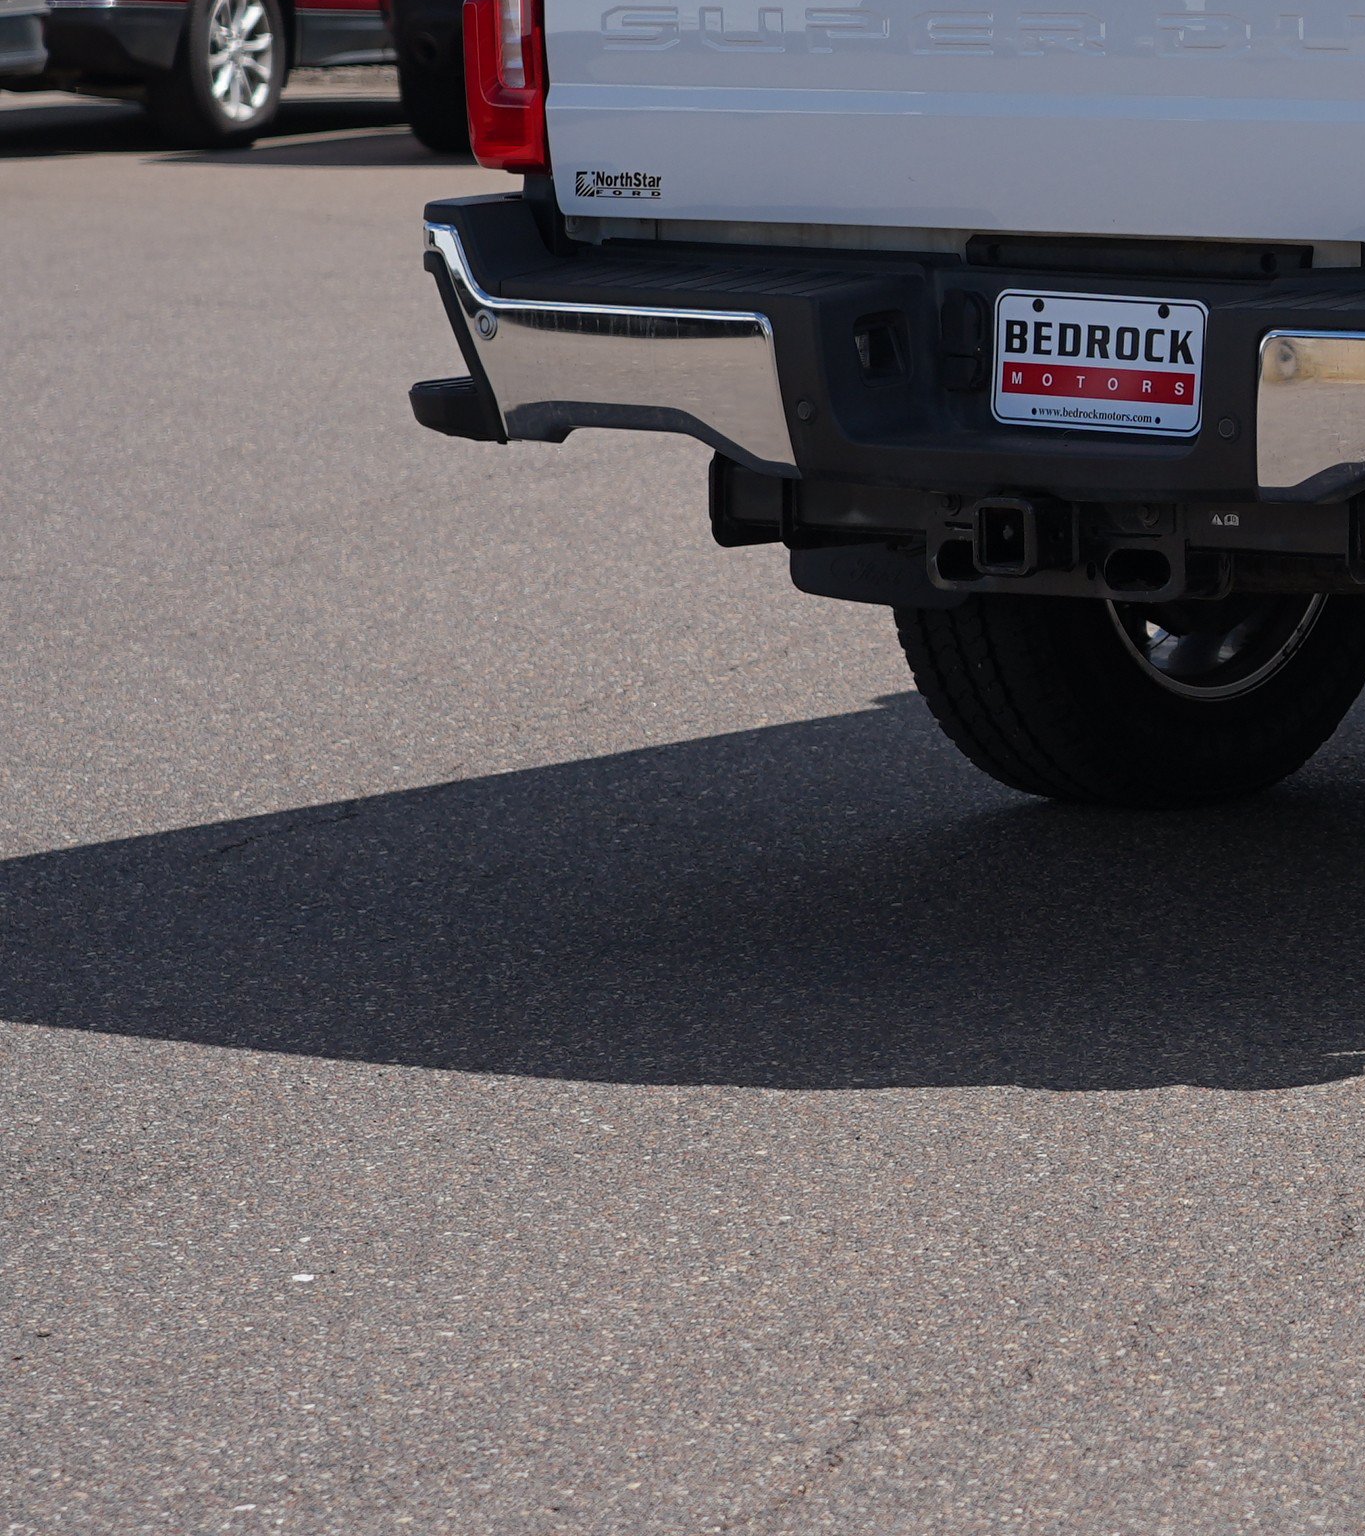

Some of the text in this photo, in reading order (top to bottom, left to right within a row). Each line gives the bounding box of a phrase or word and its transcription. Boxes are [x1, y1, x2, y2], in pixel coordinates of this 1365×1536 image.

[601, 5, 1106, 57] SUPER
[596, 171, 662, 188] NorthStar
[596, 189, 661, 197] FORD
[1004, 319, 1195, 365] BEDROCK
[1011, 371, 1185, 396] MOTORS
[1038, 406, 1152, 424] www.bedrockmotors.com
